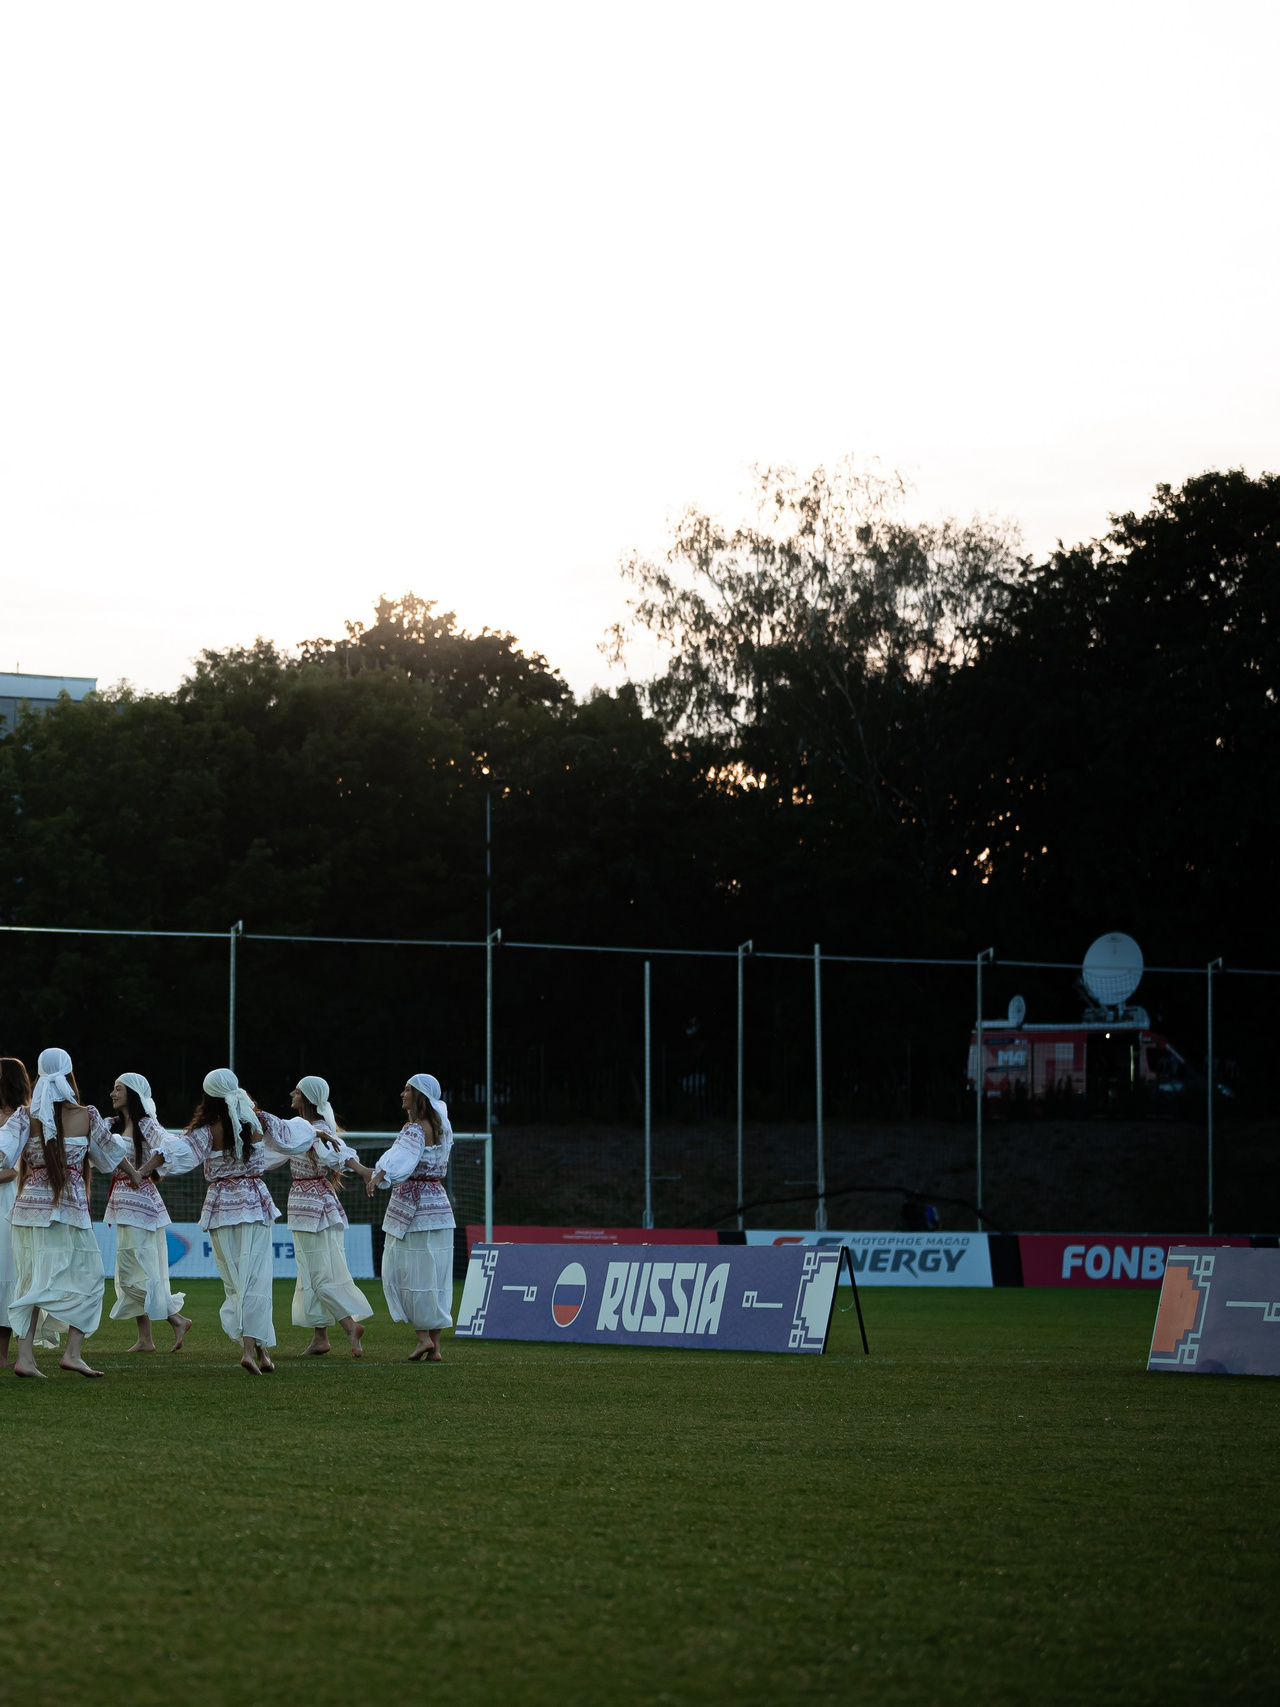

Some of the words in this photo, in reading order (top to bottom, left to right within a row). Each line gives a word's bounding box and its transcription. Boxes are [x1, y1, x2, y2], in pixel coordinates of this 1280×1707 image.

[851, 1236, 922, 1246] МОТОРНОЕ
[926, 1237, 970, 1247] МАСЛО
[1061, 1244, 1165, 1280] FONB
[596, 1261, 730, 1335] RUSSIA
